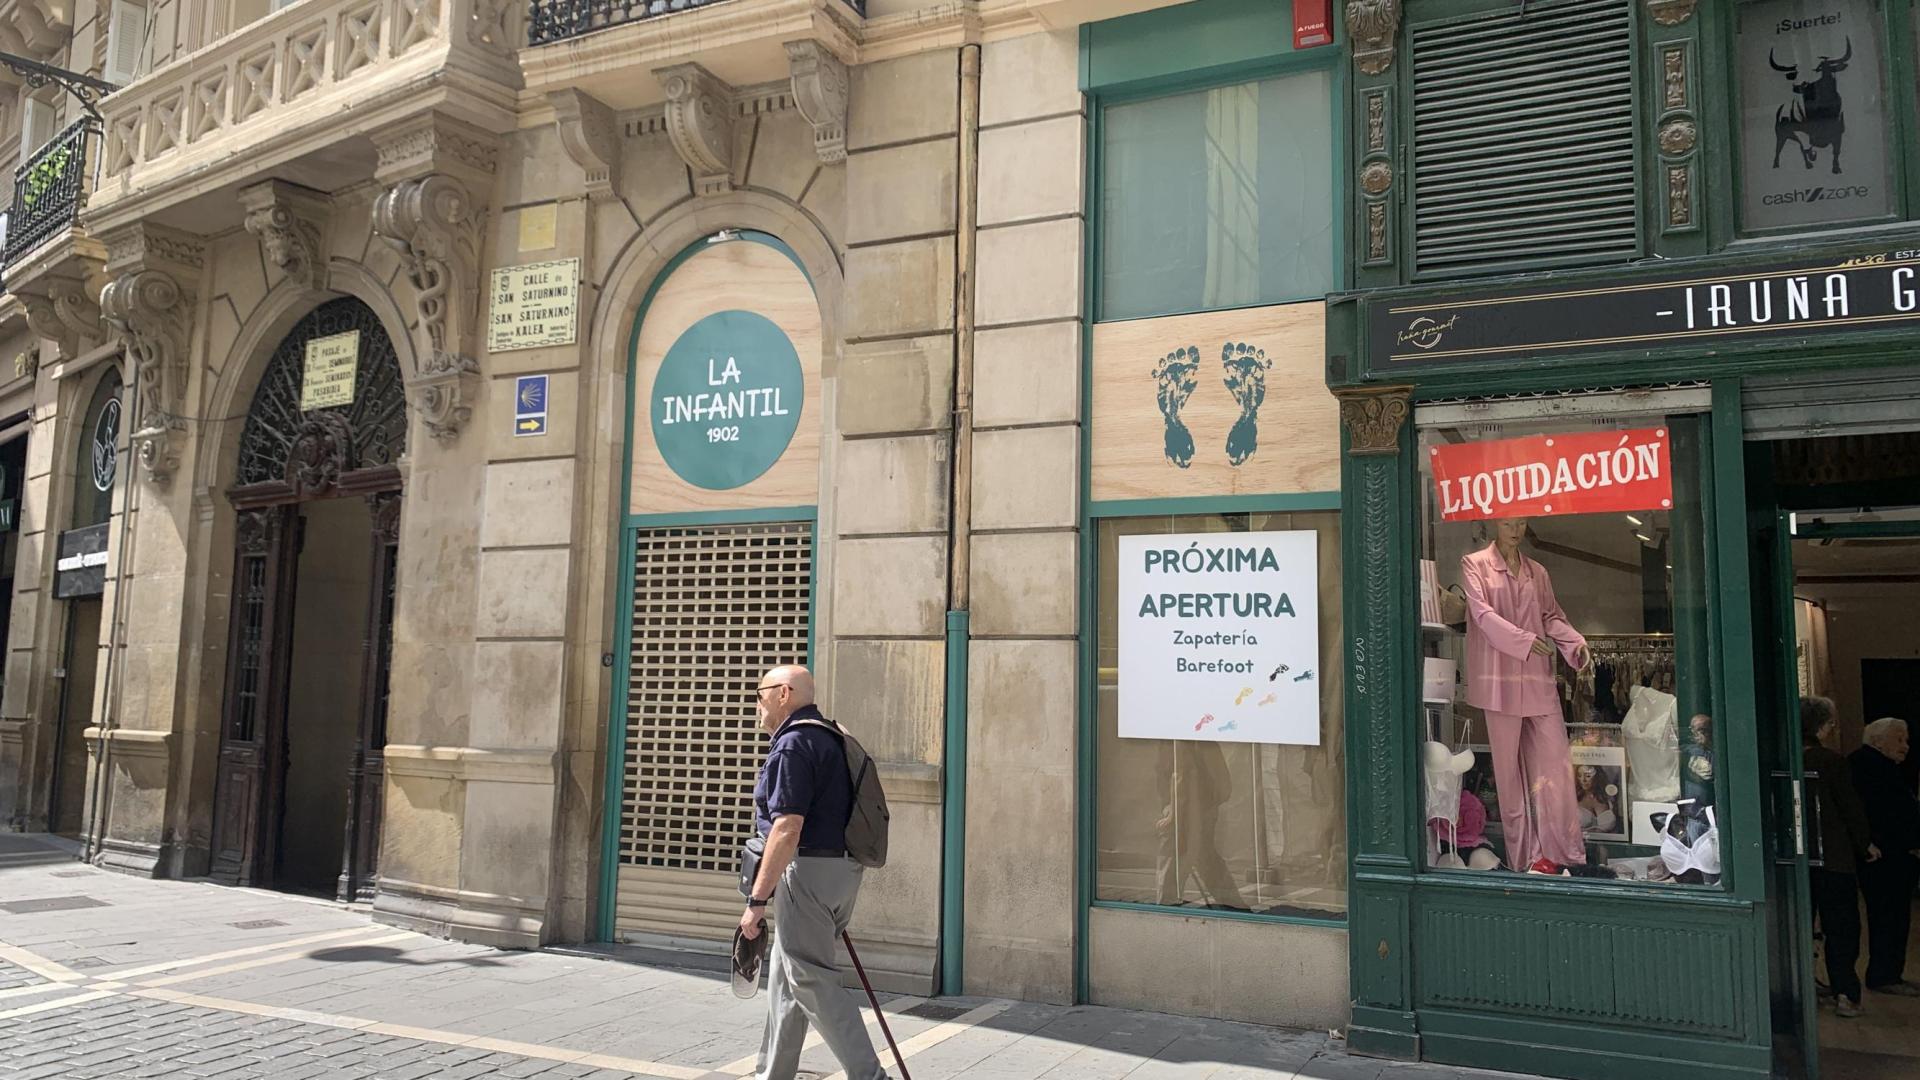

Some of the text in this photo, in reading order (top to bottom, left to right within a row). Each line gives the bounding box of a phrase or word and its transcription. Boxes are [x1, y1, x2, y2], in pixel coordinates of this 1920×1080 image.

[1776, 12, 1842, 35] ¡Suerte!
[1762, 184, 1869, 207] cash zone
[523, 273, 550, 286] CALLE
[498, 286, 569, 305] SAN SATURNINO
[495, 306, 570, 325] SAN SATURNINO
[515, 323, 545, 337] KALEA
[708, 356, 742, 386] LA
[662, 387, 789, 425] INFANTIL
[706, 425, 740, 443] 1902
[1440, 434, 1661, 515] LIQUIDACIÓN
[1144, 541, 1280, 574] PRÓXIMA
[1138, 592, 1296, 618] APERTURA
[1173, 629, 1258, 649] Zapatería
[1176, 657, 1255, 674] Barefoot
